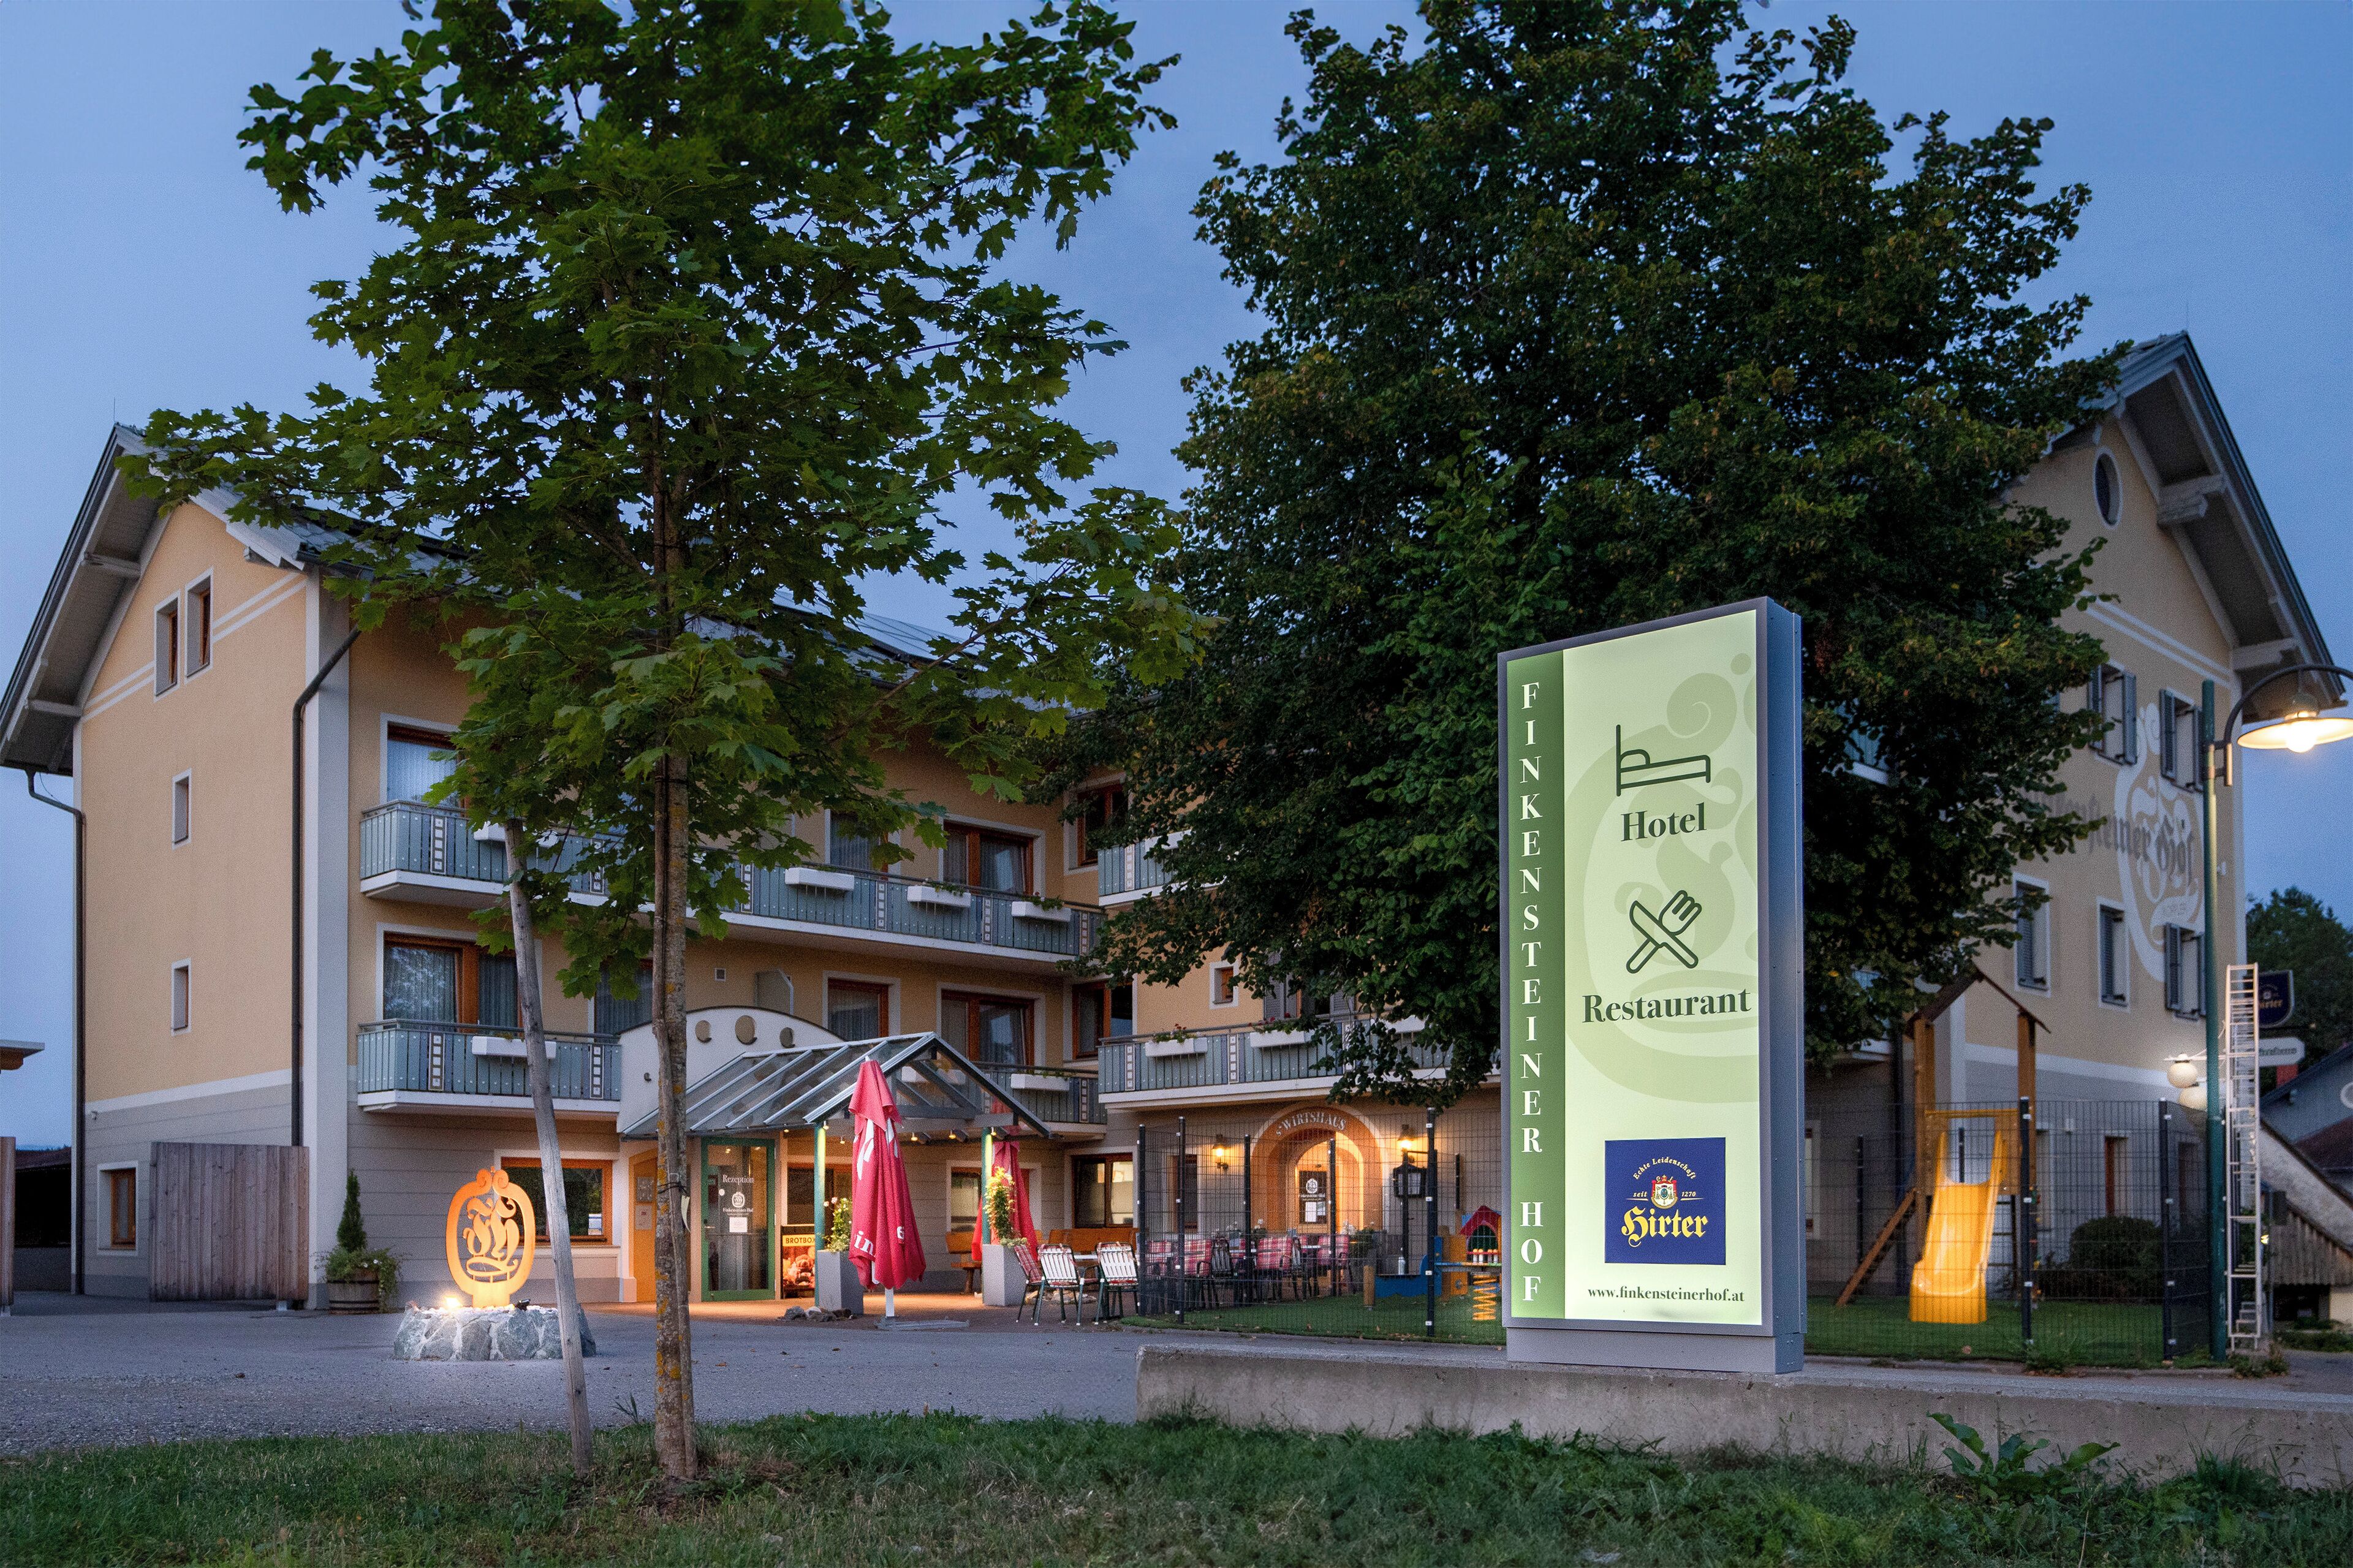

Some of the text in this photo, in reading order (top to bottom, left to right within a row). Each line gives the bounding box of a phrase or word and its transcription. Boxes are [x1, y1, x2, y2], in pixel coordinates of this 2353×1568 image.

[1621, 802, 1706, 842] Hotel
[1519, 682, 1544, 1301] FINKENSTEINER HOF
[1582, 989, 1752, 1023] Restaurant
[722, 1174, 755, 1186] Rezeption
[1632, 1156, 1697, 1180] Echte Leidenschaft
[1621, 1205, 1709, 1248] Hirter
[1588, 1286, 1745, 1302] www.finkensteinerhof.at
